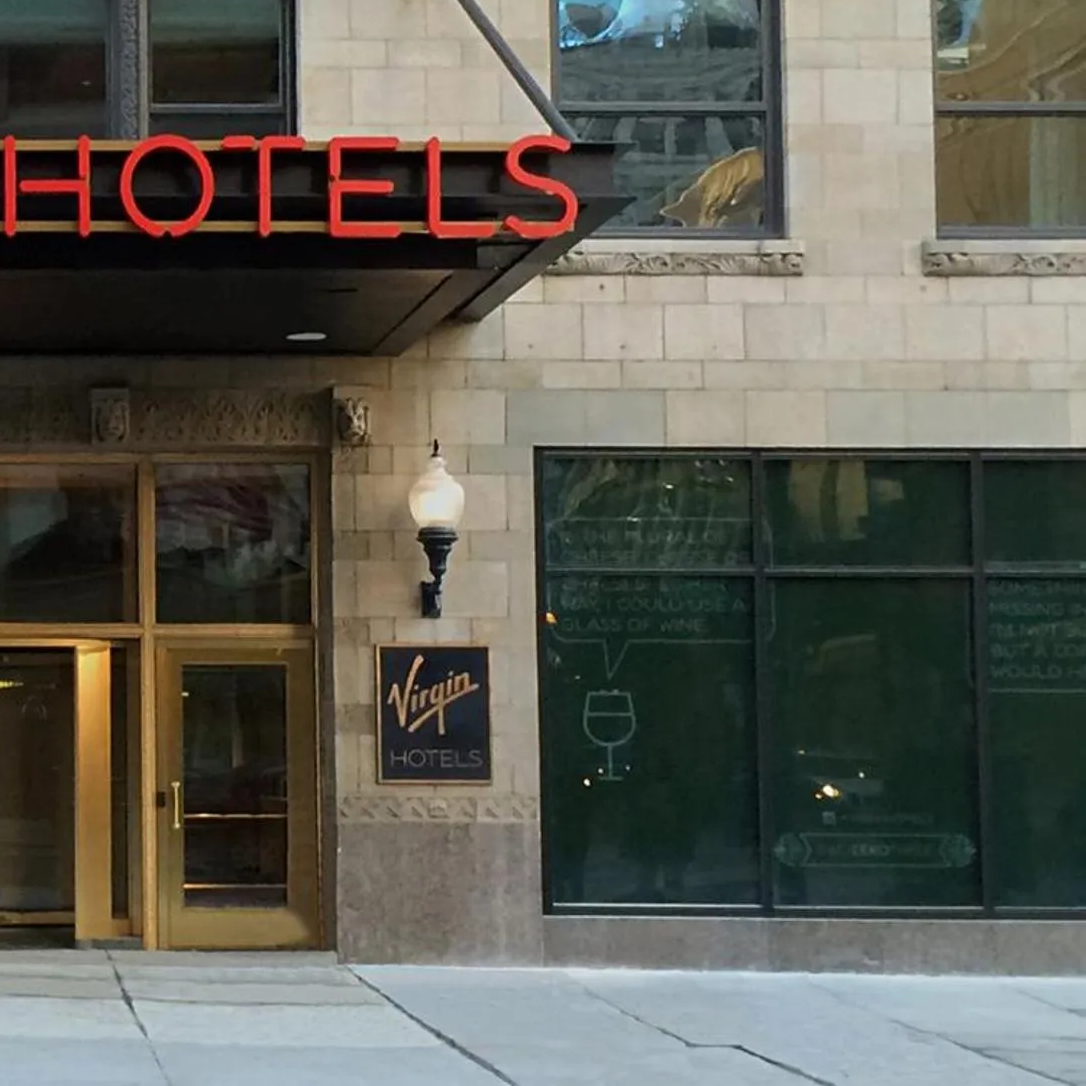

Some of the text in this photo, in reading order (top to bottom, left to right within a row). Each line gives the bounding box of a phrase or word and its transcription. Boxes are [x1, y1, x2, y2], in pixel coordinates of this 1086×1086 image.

[3, 133, 579, 239] HOTELS
[732, 597, 747, 612] A
[562, 617, 710, 632] GLASS OF WINE
[387, 654, 480, 735] Virgin
[390, 749, 484, 768] HOTELS
